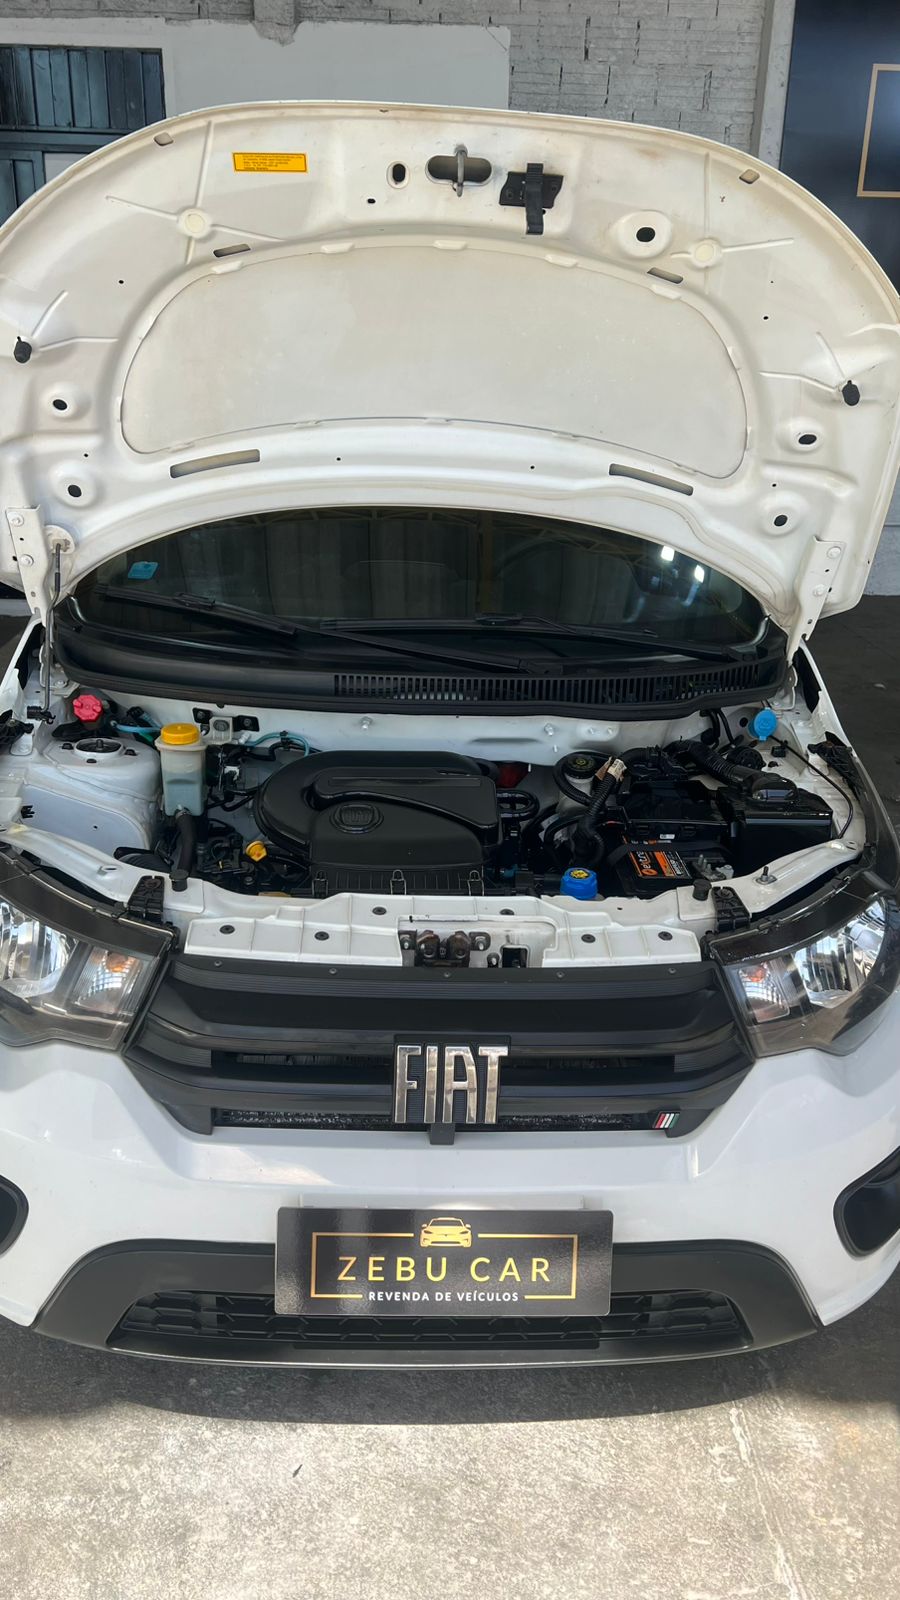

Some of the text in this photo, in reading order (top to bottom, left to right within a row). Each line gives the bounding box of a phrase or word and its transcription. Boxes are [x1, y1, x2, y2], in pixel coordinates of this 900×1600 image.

[394, 1045, 509, 1124] FIAT
[337, 1256, 550, 1282] ZEBU CAR
[368, 1289, 519, 1303] REVENDA DE VEÍCULOS
